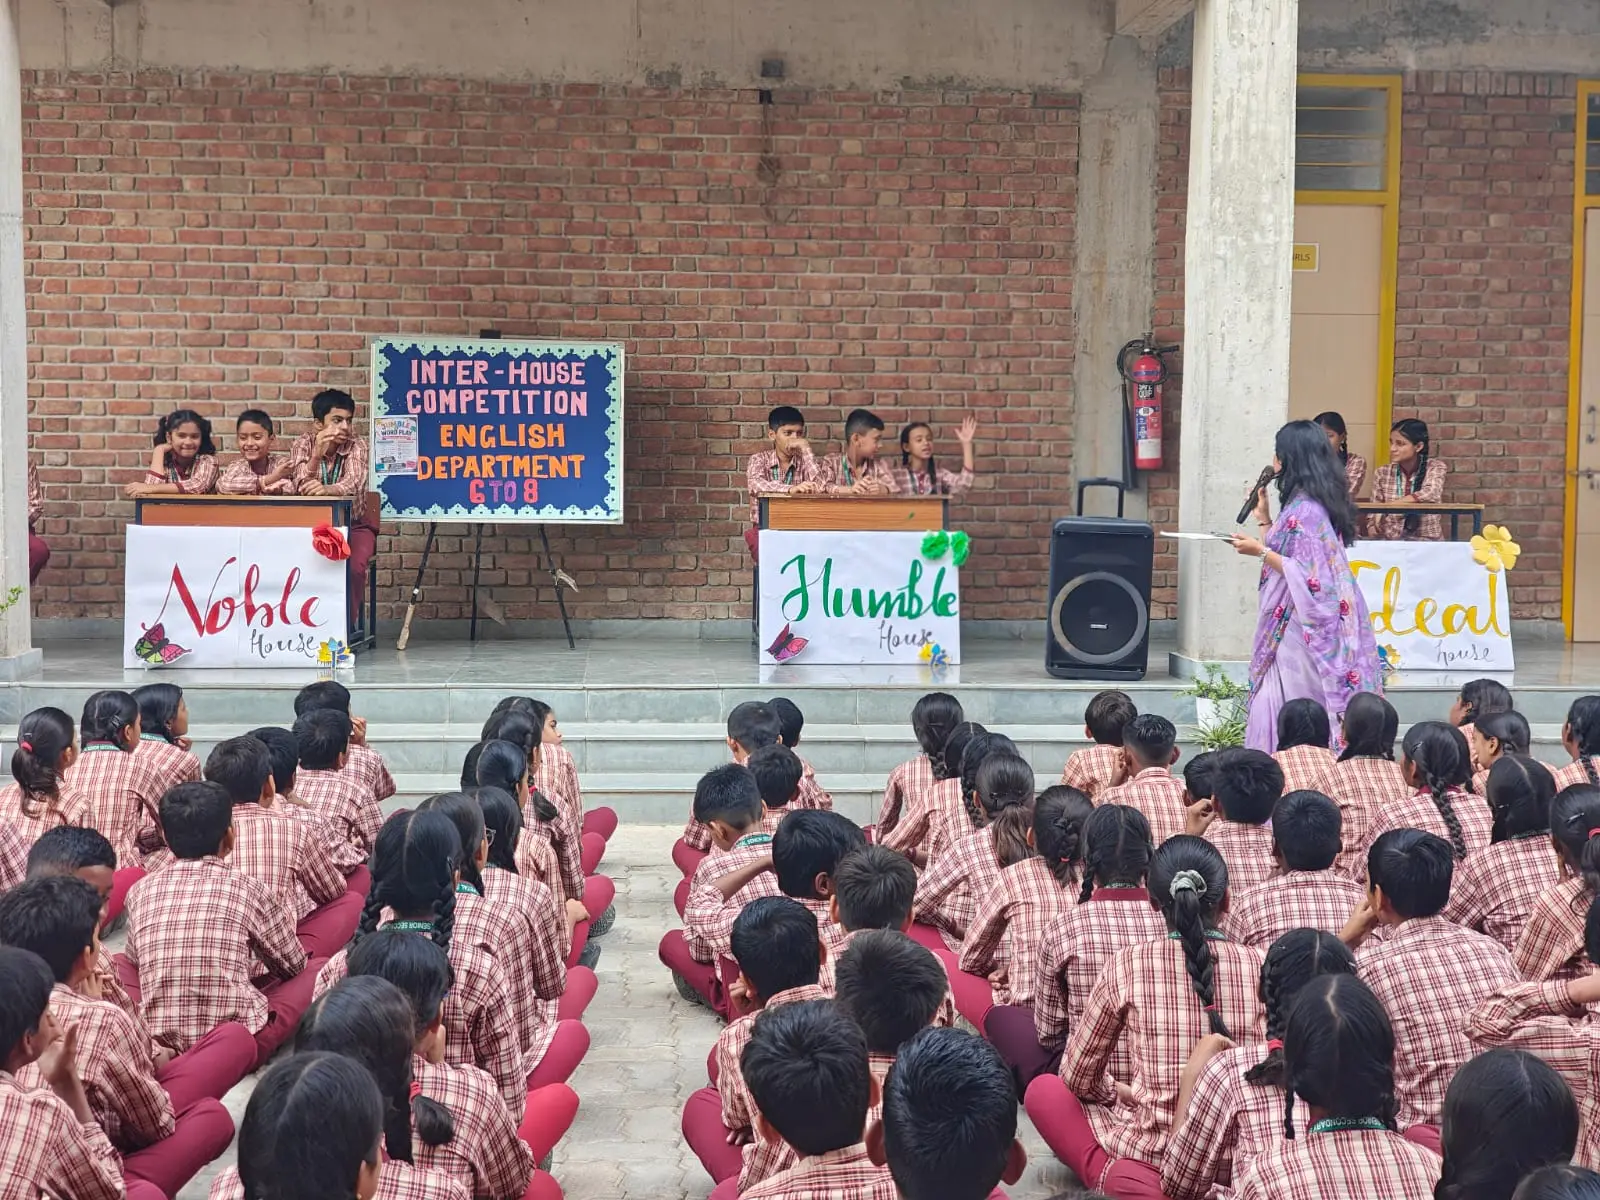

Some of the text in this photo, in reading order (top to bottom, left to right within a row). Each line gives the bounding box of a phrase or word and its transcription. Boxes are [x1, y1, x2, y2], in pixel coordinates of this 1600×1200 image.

[406, 389, 588, 416] COMPETITION
[440, 423, 566, 449] ENGLISH
[417, 454, 585, 481] DEPARTMENT
[469, 478, 538, 504] 6 TO 8
[141, 556, 328, 638] Noble
[780, 554, 958, 622] Humble
[250, 629, 320, 659] House
[878, 619, 934, 655] House
